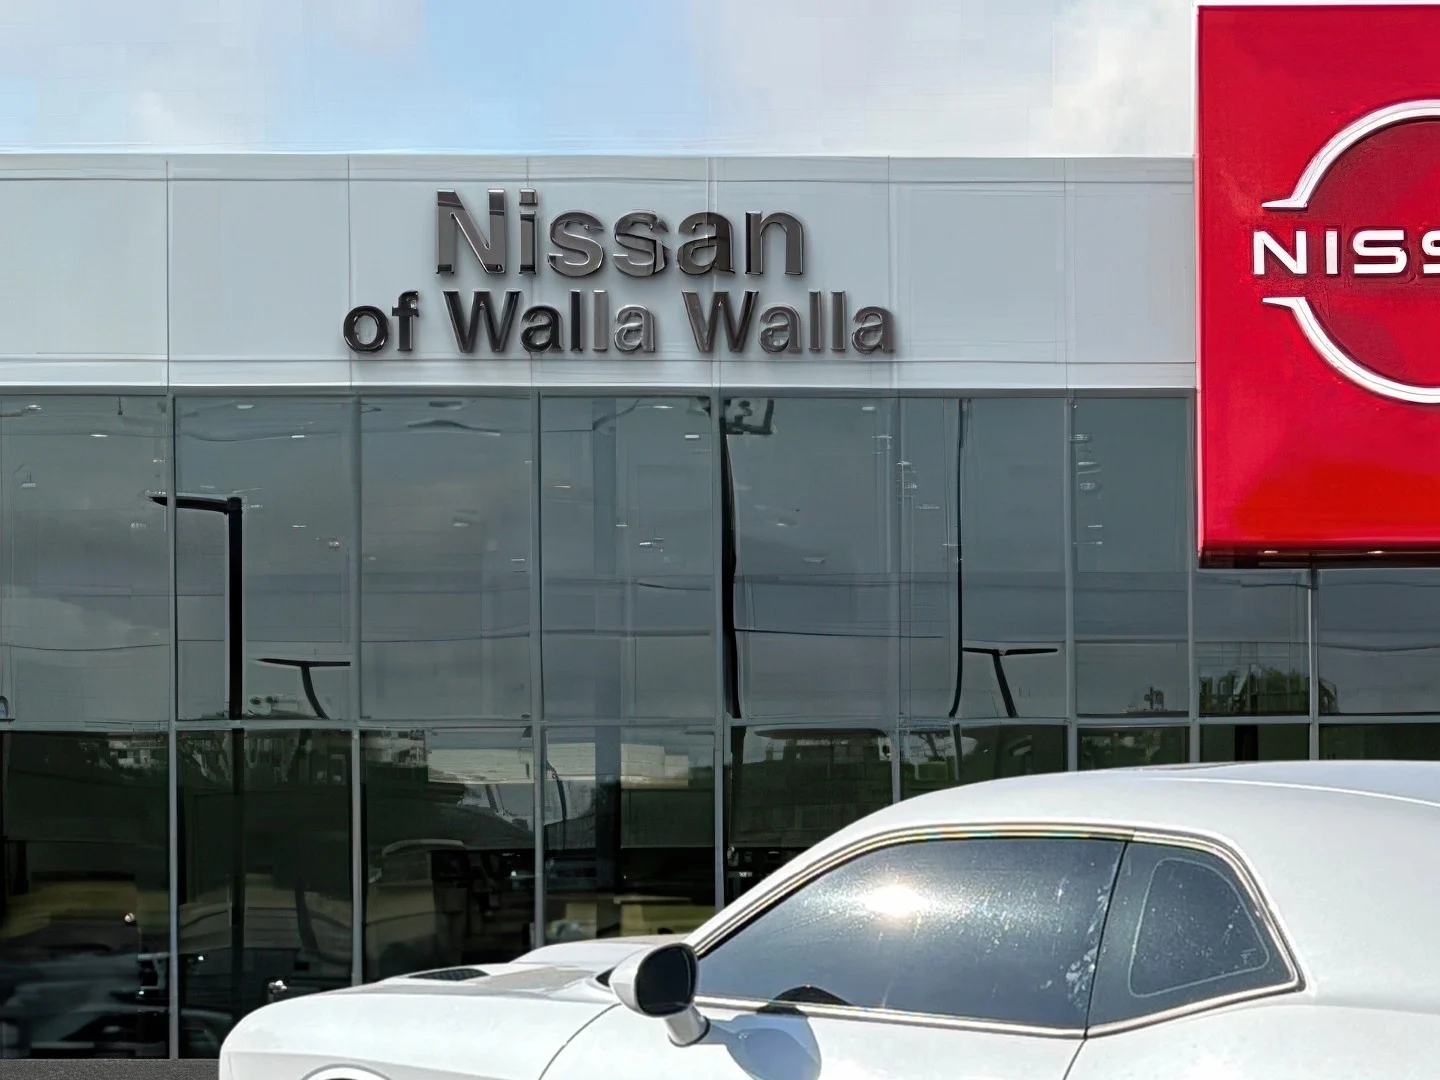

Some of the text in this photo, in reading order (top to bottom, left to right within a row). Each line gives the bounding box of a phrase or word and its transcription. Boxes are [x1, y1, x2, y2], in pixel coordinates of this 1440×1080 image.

[435, 187, 807, 276] Nissan
[342, 289, 895, 354] of Walla Walla
